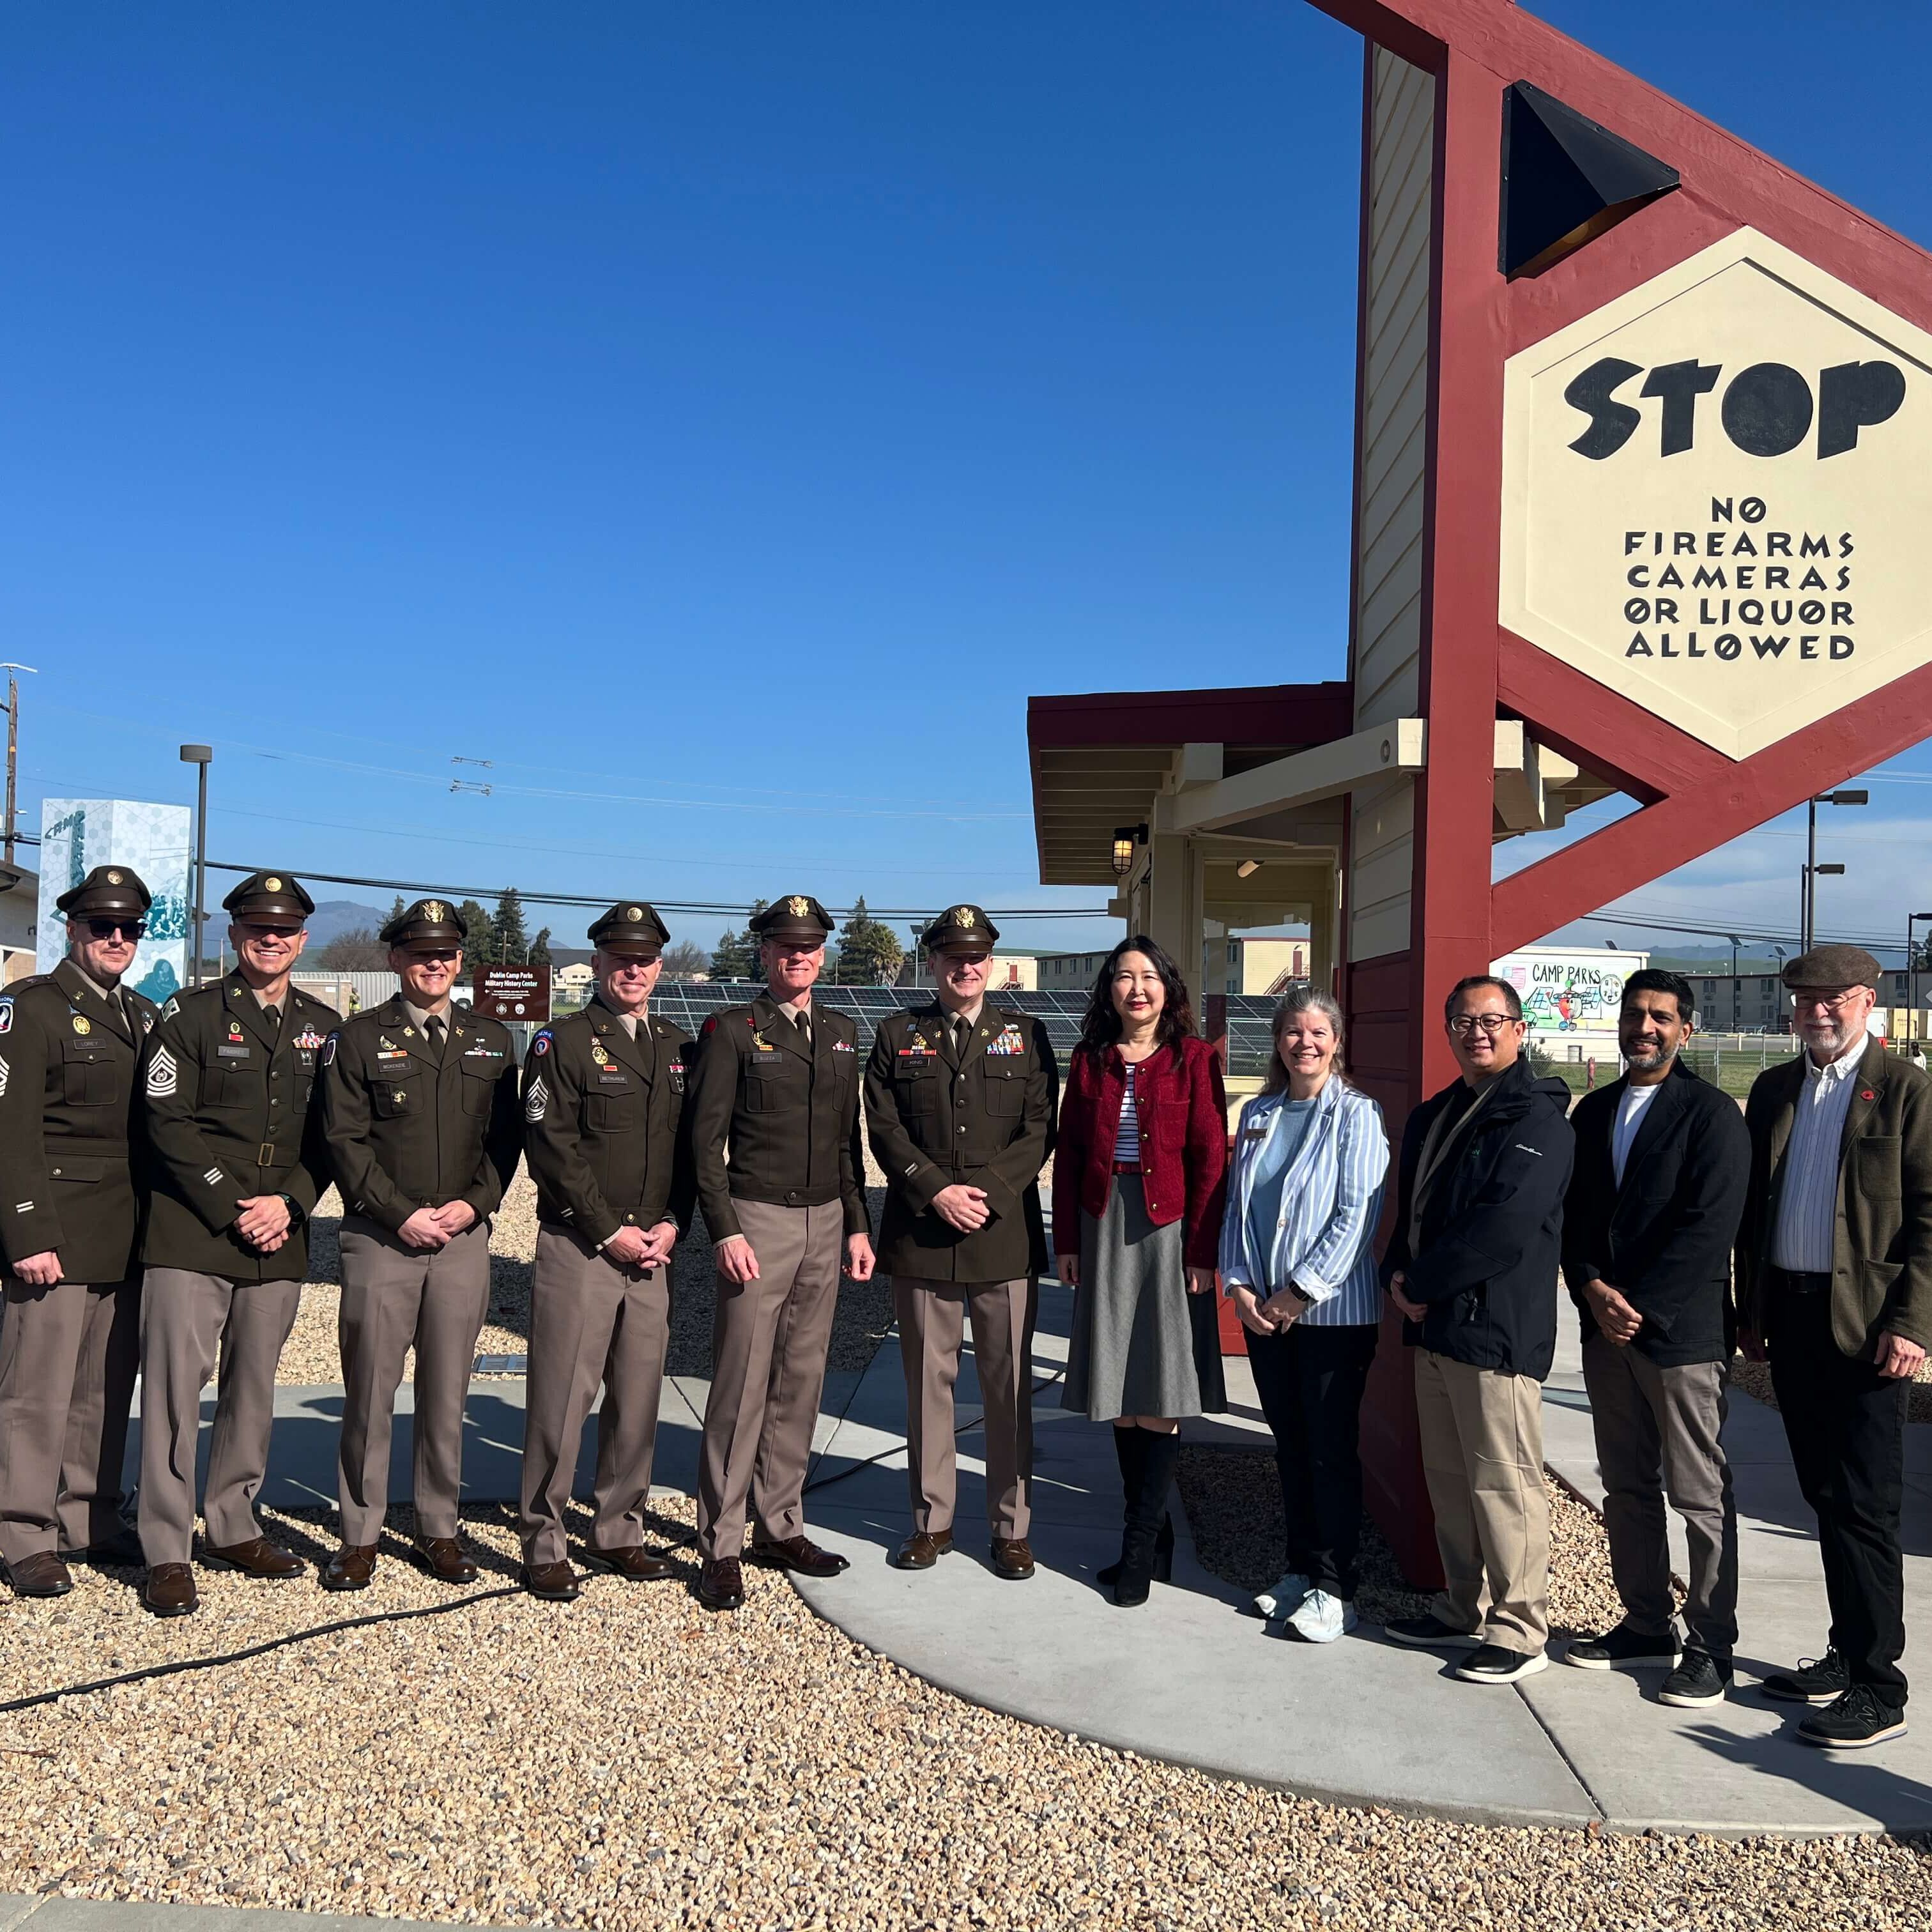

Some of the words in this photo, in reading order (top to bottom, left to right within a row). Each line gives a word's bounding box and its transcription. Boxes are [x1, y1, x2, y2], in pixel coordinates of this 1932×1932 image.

[1564, 357, 1906, 460] STOP
[1712, 496, 1767, 523] NO
[1625, 531, 1854, 558] FIREARMS
[1627, 563, 1850, 591] CAMERAS
[1624, 597, 1680, 625] OR
[1700, 599, 1855, 625] LIQUOR
[1625, 631, 1854, 661] ALLOWED
[485, 979, 503, 988] Military
[504, 979, 521, 988] History
[506, 972, 519, 980] Camp
[1533, 963, 1563, 983] CAMP
[1568, 966, 1600, 985] PARKS
